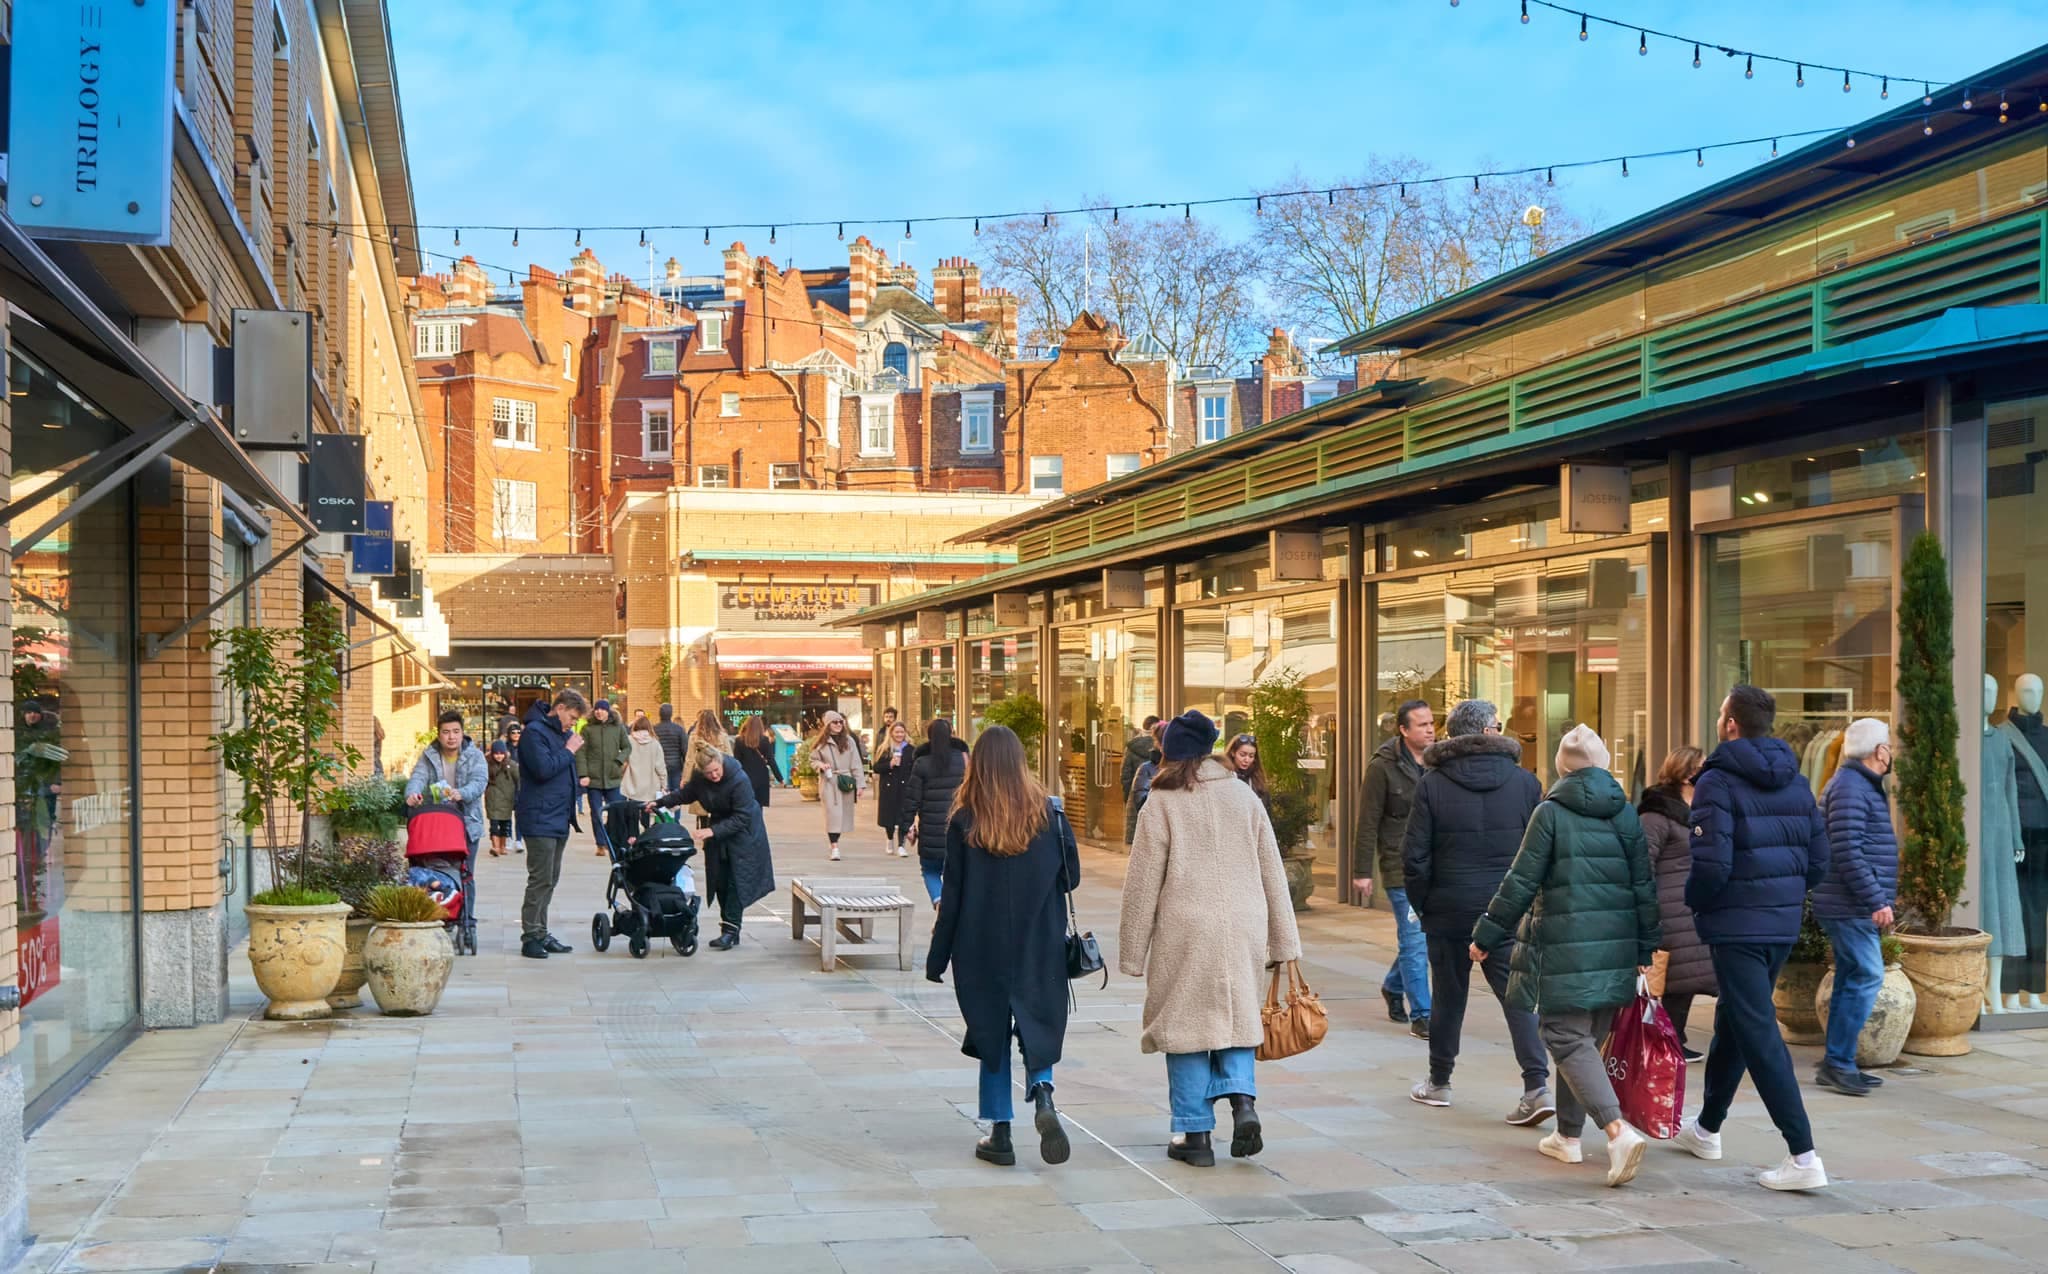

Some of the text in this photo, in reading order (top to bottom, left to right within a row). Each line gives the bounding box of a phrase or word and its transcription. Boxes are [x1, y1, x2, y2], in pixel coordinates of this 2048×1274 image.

[76, 35, 101, 193] TRILOGY
[318, 497, 356, 505] OSKA
[1279, 551, 1321, 561] JOSEPH
[738, 585, 861, 604] COMPTOIR
[485, 674, 549, 685] ORTIGIA
[1607, 1056, 1628, 1081] &S
